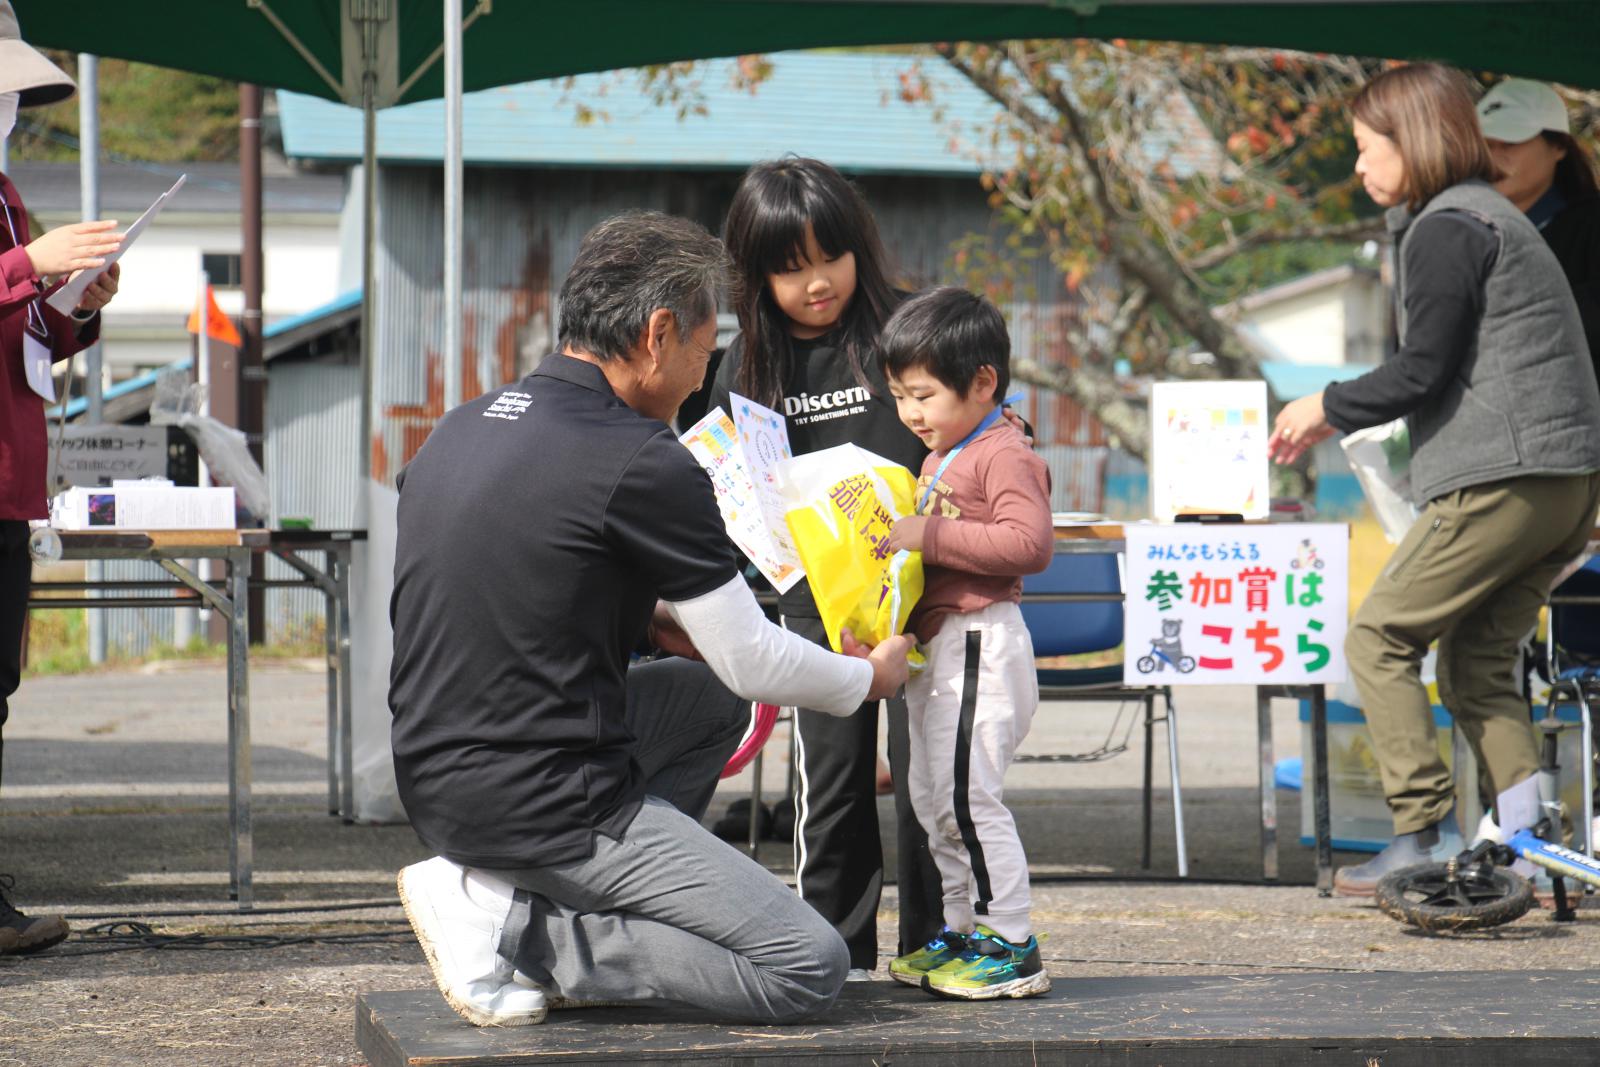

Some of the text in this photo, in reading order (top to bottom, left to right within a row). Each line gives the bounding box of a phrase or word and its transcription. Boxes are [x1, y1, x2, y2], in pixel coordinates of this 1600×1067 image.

[784, 386, 871, 416] Discern
[795, 405, 867, 426] TRY SOMETHING NEW.
[1147, 542, 1261, 560] みんなもらえる
[1145, 566, 1324, 612] 参加賞は
[1199, 619, 1331, 673] こちら
